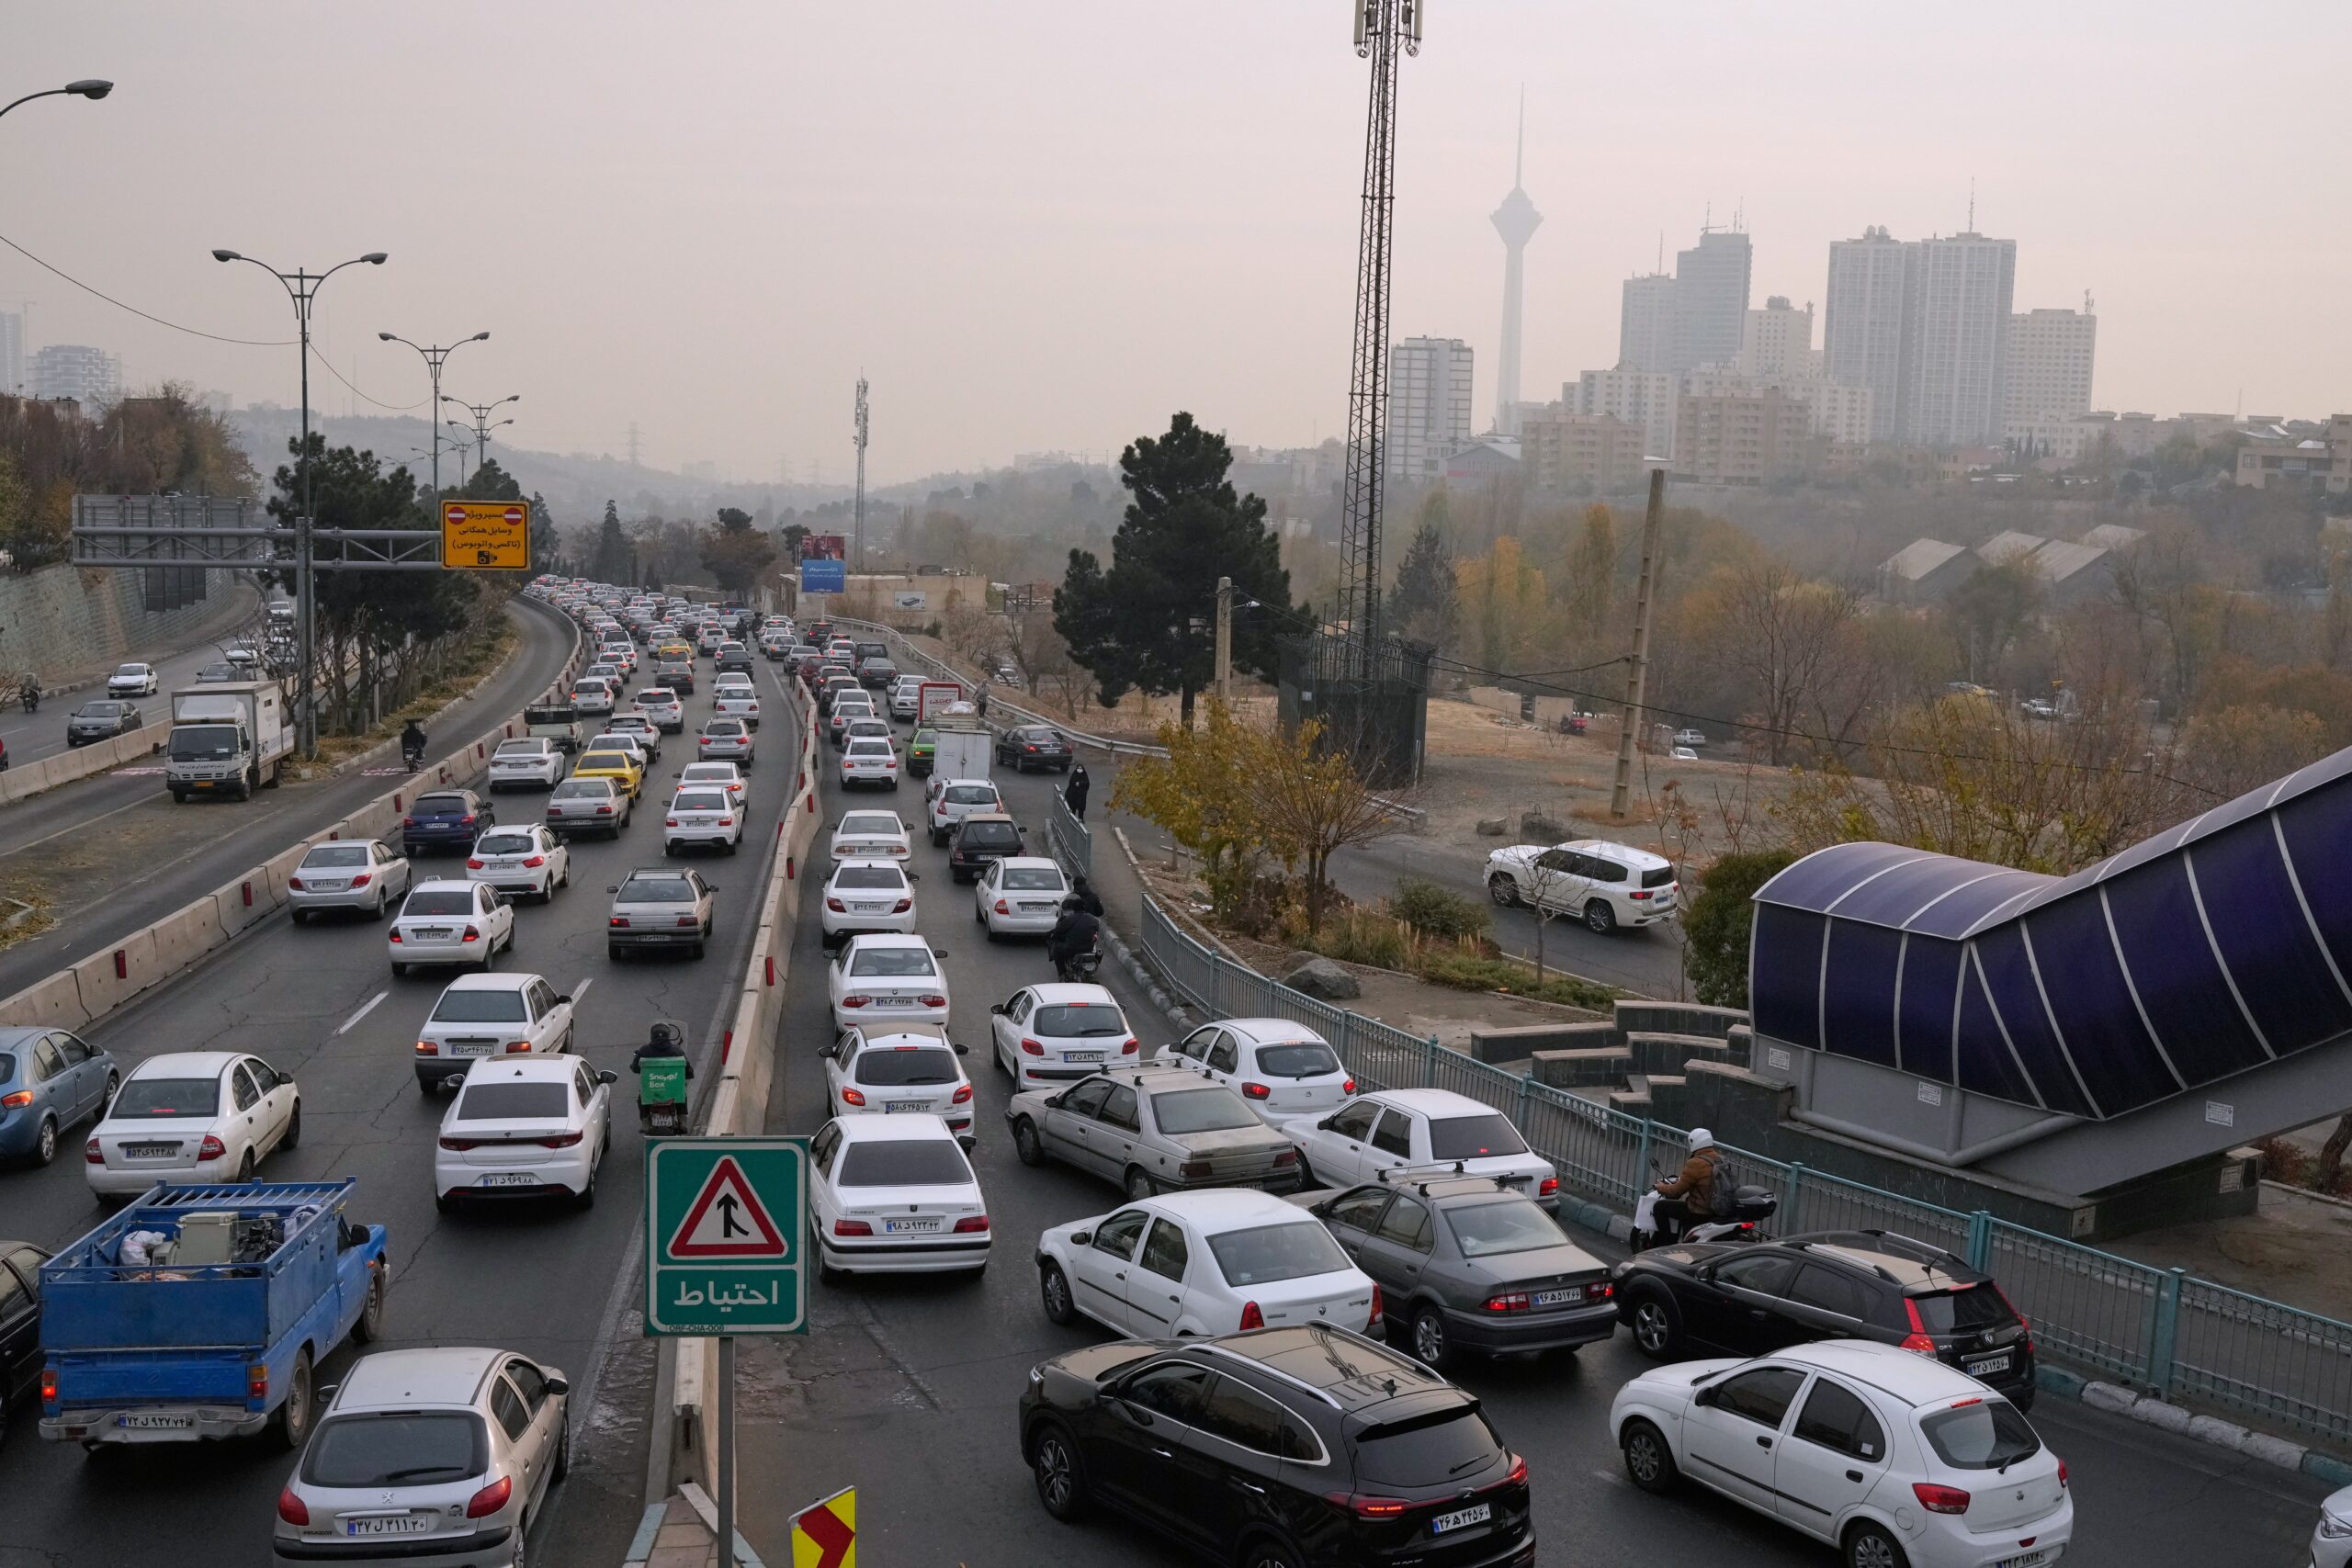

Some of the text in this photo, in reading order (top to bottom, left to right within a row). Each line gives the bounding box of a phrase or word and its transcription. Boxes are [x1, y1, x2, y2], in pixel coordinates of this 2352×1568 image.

[467, 511, 504, 520] مسیر ویژه
[458, 525, 513, 536] وسایل همگانی
[673, 1280, 778, 1313] احتیاط
